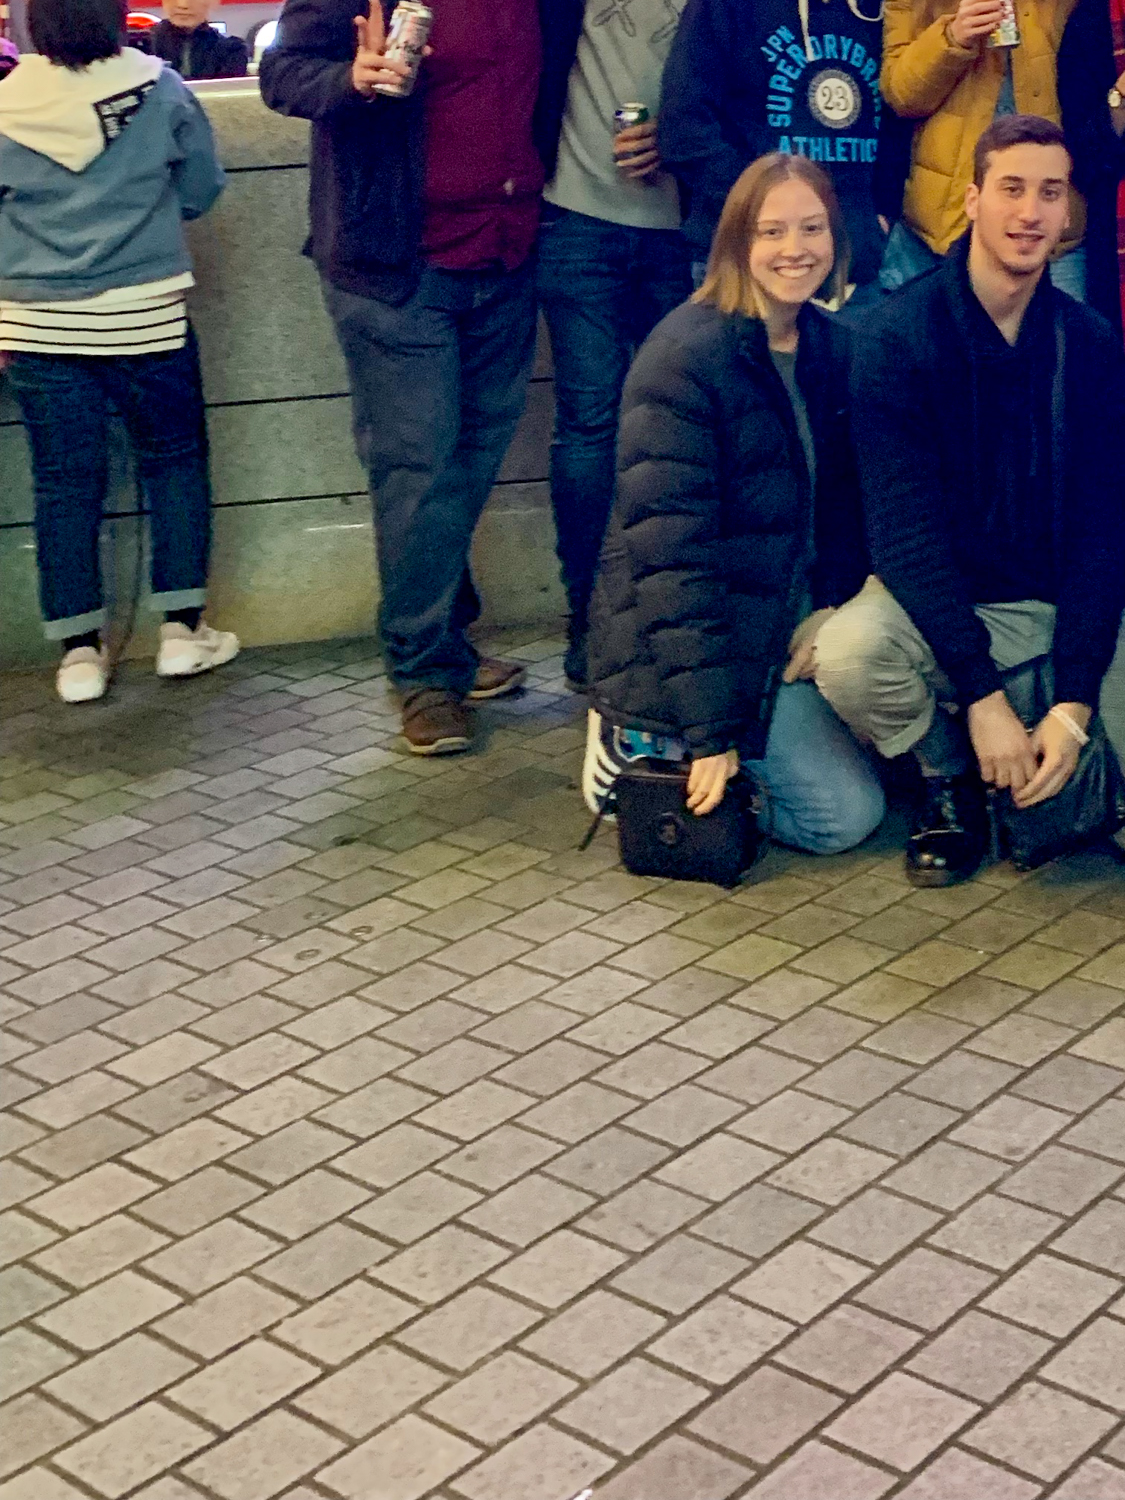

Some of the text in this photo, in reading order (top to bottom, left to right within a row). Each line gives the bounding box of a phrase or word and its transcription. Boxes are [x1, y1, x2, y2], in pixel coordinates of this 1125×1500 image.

[760, 24, 796, 62] JPN
[821, 85, 850, 112] 23
[778, 135, 880, 163] ATHLETIC
